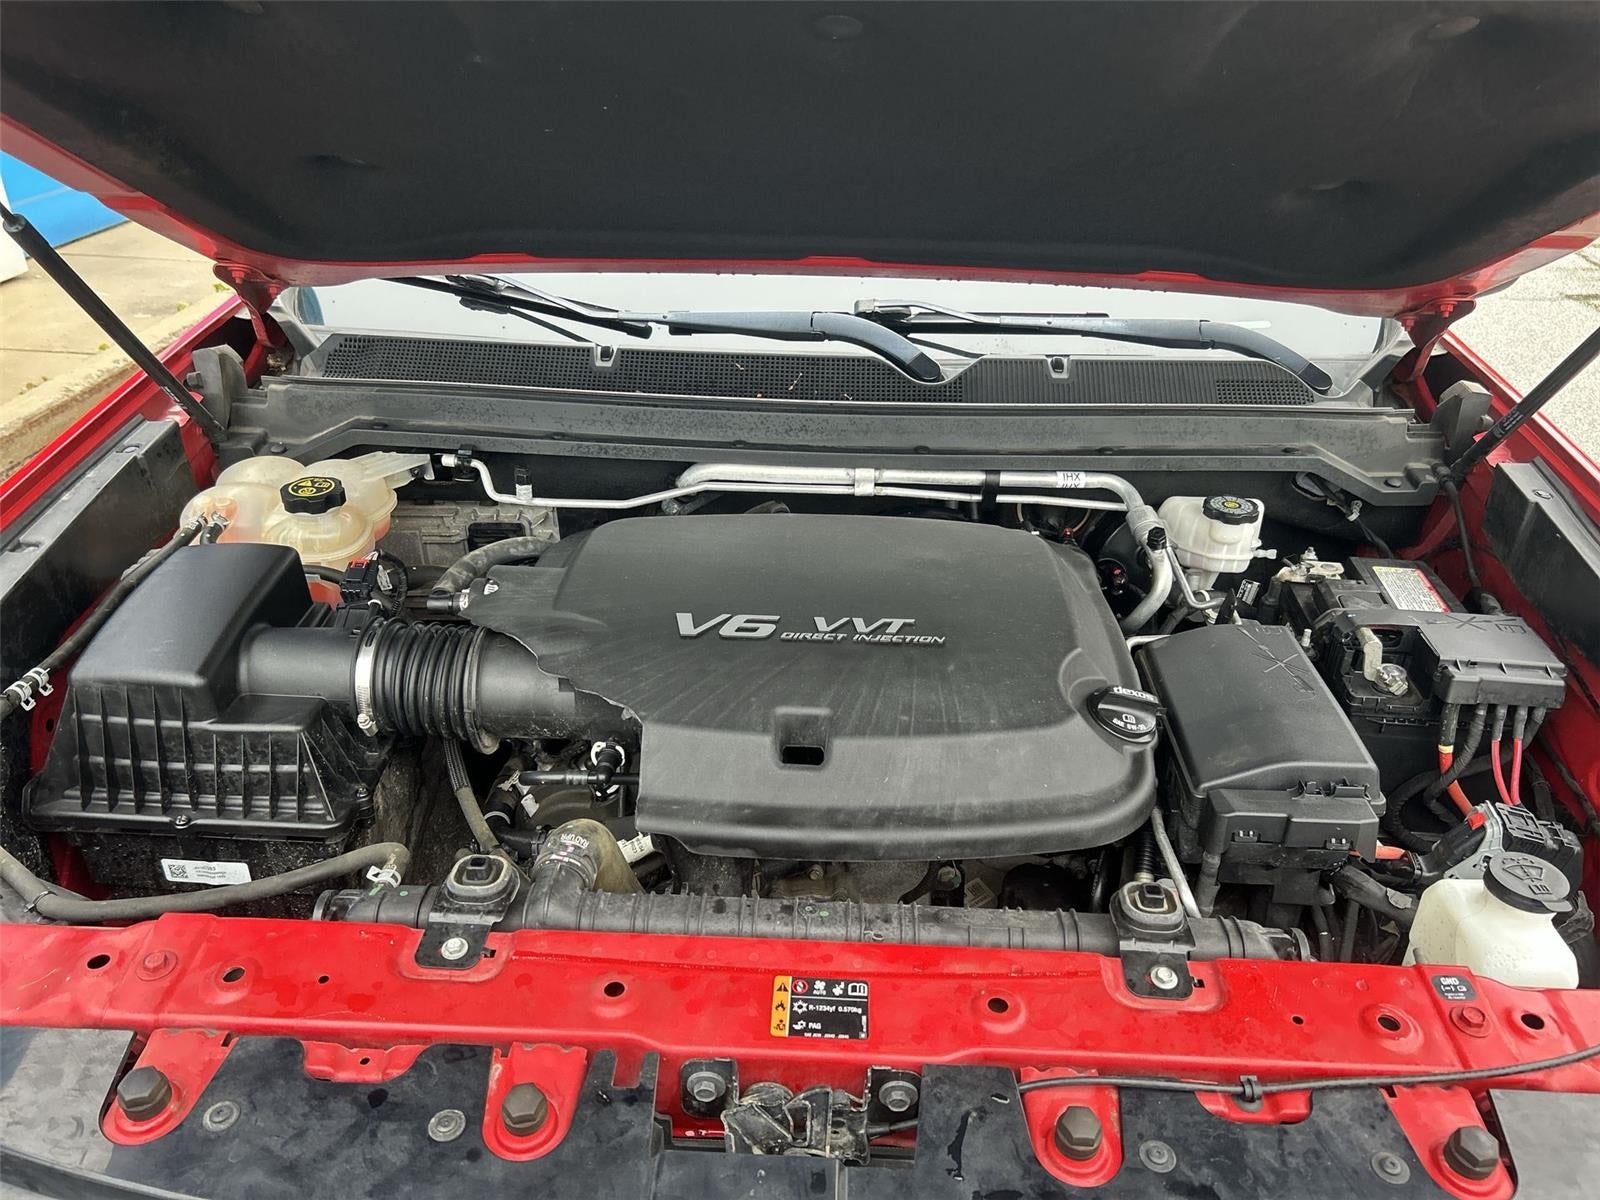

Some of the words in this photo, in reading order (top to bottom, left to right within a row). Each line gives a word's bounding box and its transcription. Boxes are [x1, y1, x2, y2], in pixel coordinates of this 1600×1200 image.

[676, 612, 781, 640] V6
[814, 616, 916, 634] VVT
[780, 631, 848, 643] DIRECT
[852, 633, 946, 645] INJECTION
[808, 1004, 836, 1013] R-1234yf
[808, 1022, 822, 1030] PAG
